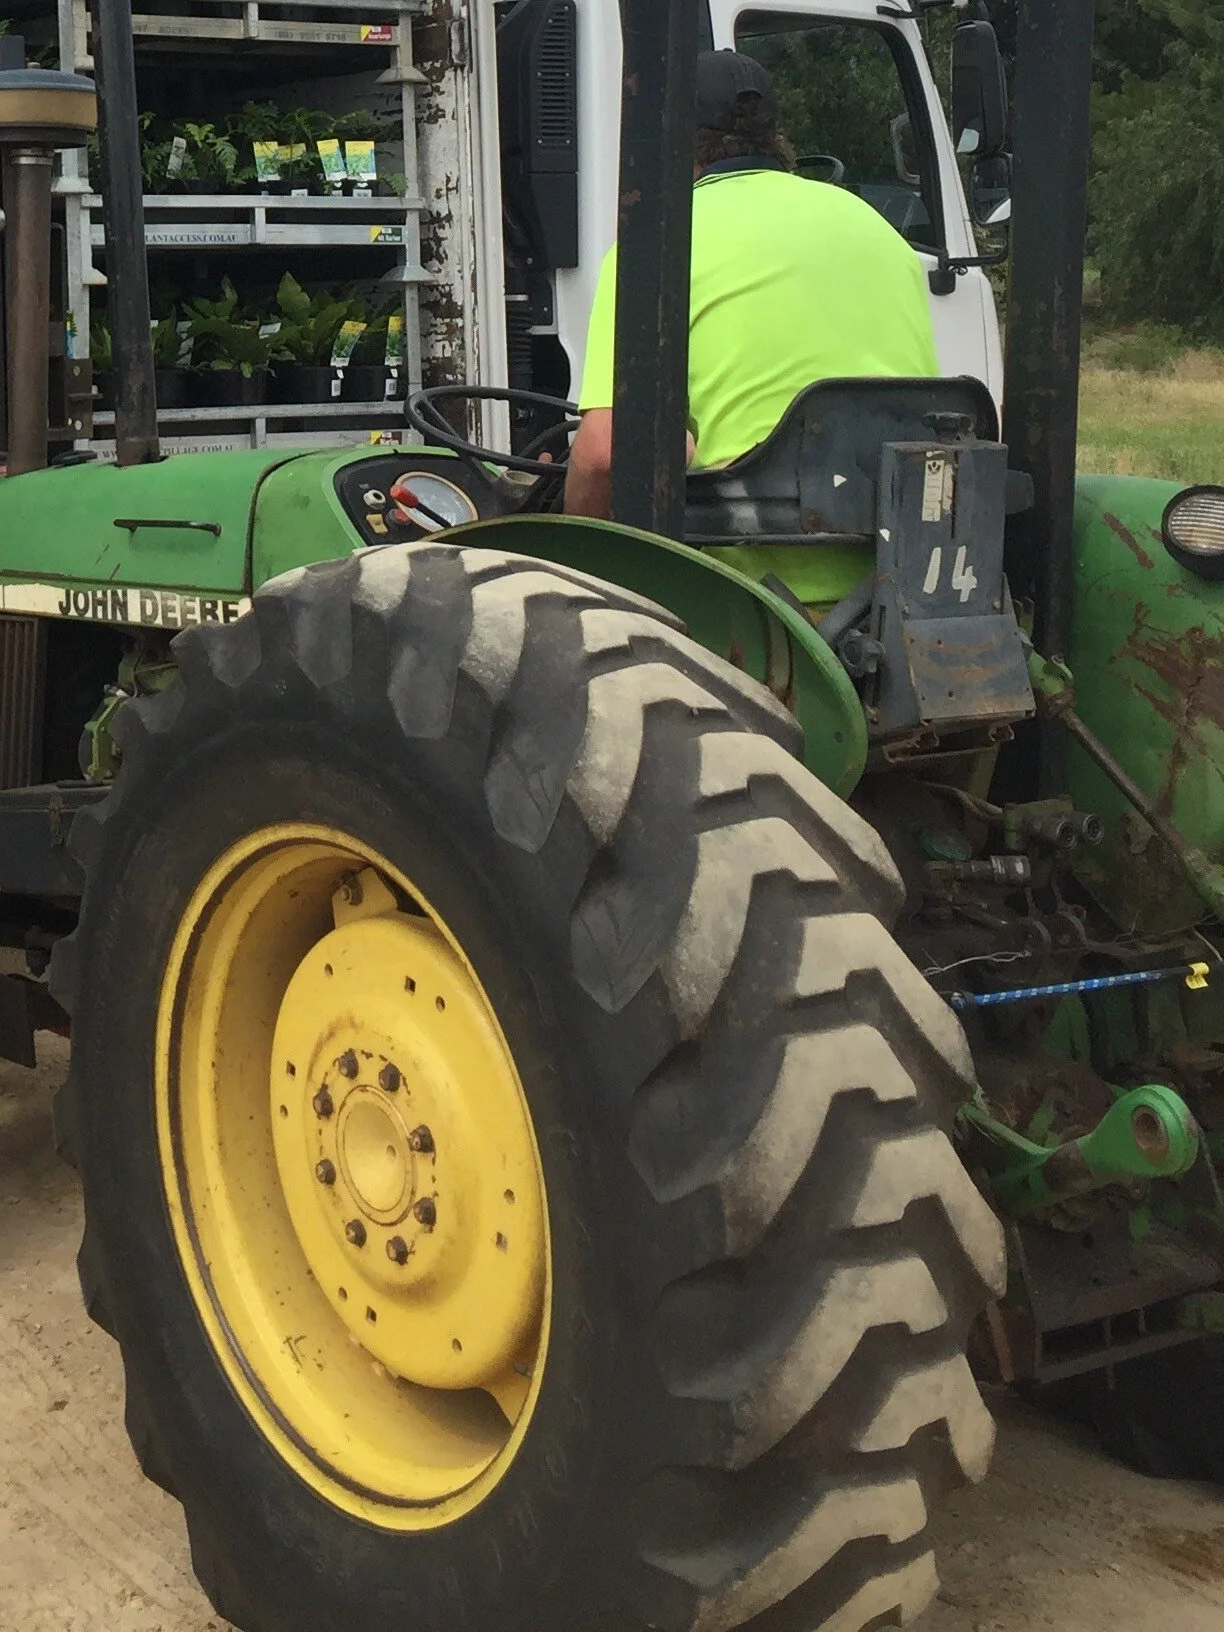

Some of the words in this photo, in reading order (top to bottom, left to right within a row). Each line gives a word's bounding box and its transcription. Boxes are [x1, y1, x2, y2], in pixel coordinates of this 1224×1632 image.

[922, 544, 978, 603] 14
[58, 588, 128, 621] JOHN
[139, 588, 241, 629] DEERE
